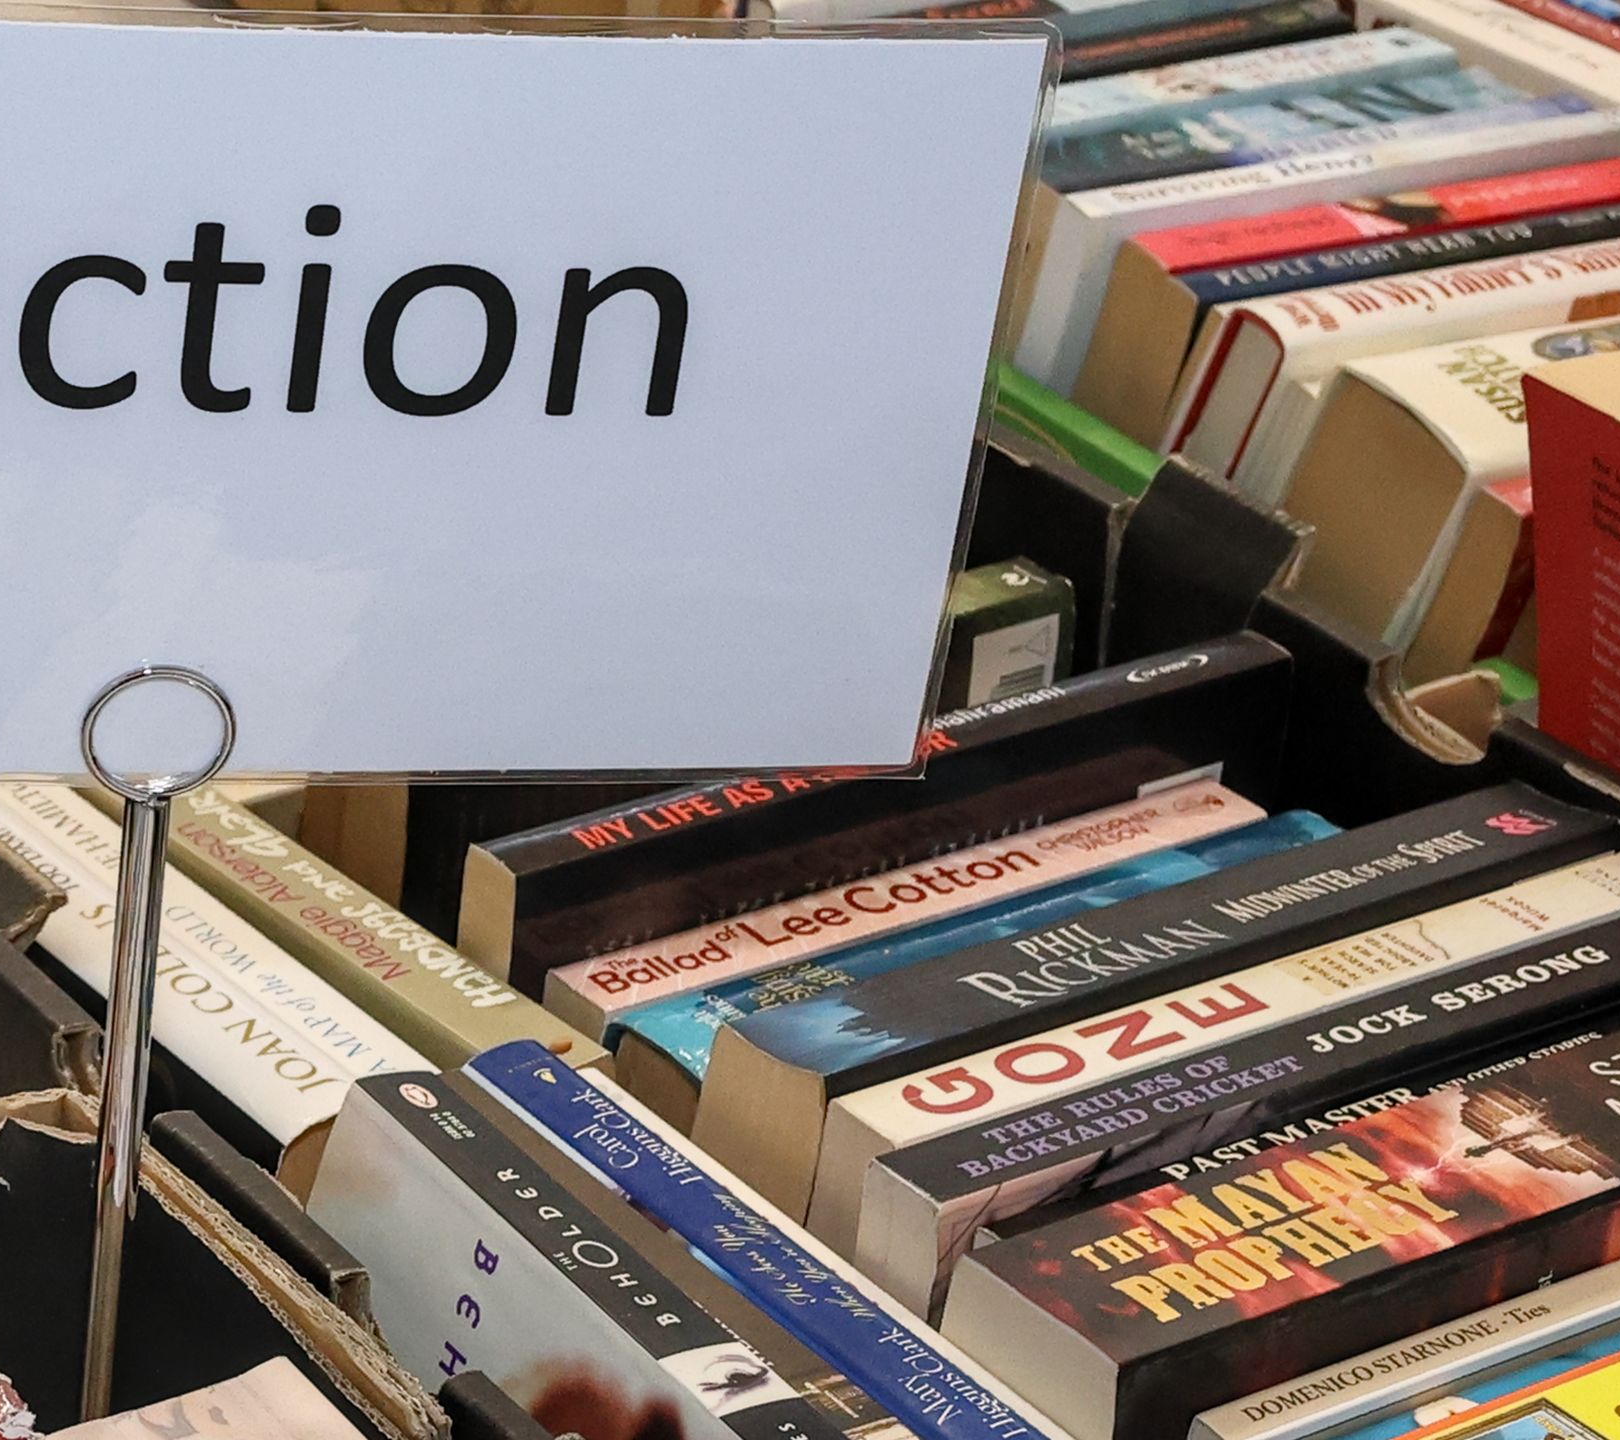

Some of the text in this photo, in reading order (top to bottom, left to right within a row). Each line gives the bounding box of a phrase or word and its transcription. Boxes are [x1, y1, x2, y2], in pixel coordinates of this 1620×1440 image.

[571, 777, 775, 851] MY LIFE AS
[588, 846, 1043, 997] Ballad of Lee Cotton
[957, 916, 1230, 1009] RICKMAN
[1011, 921, 1115, 962] PHIL
[1307, 1002, 1425, 1057] JOCK
[1441, 942, 1610, 1014] SERONG
[960, 1054, 1305, 1180] BACKYARD CRICKET
[982, 1055, 1230, 1150] THE RULES OF
[1109, 1172, 1460, 1325] PROPHECY
